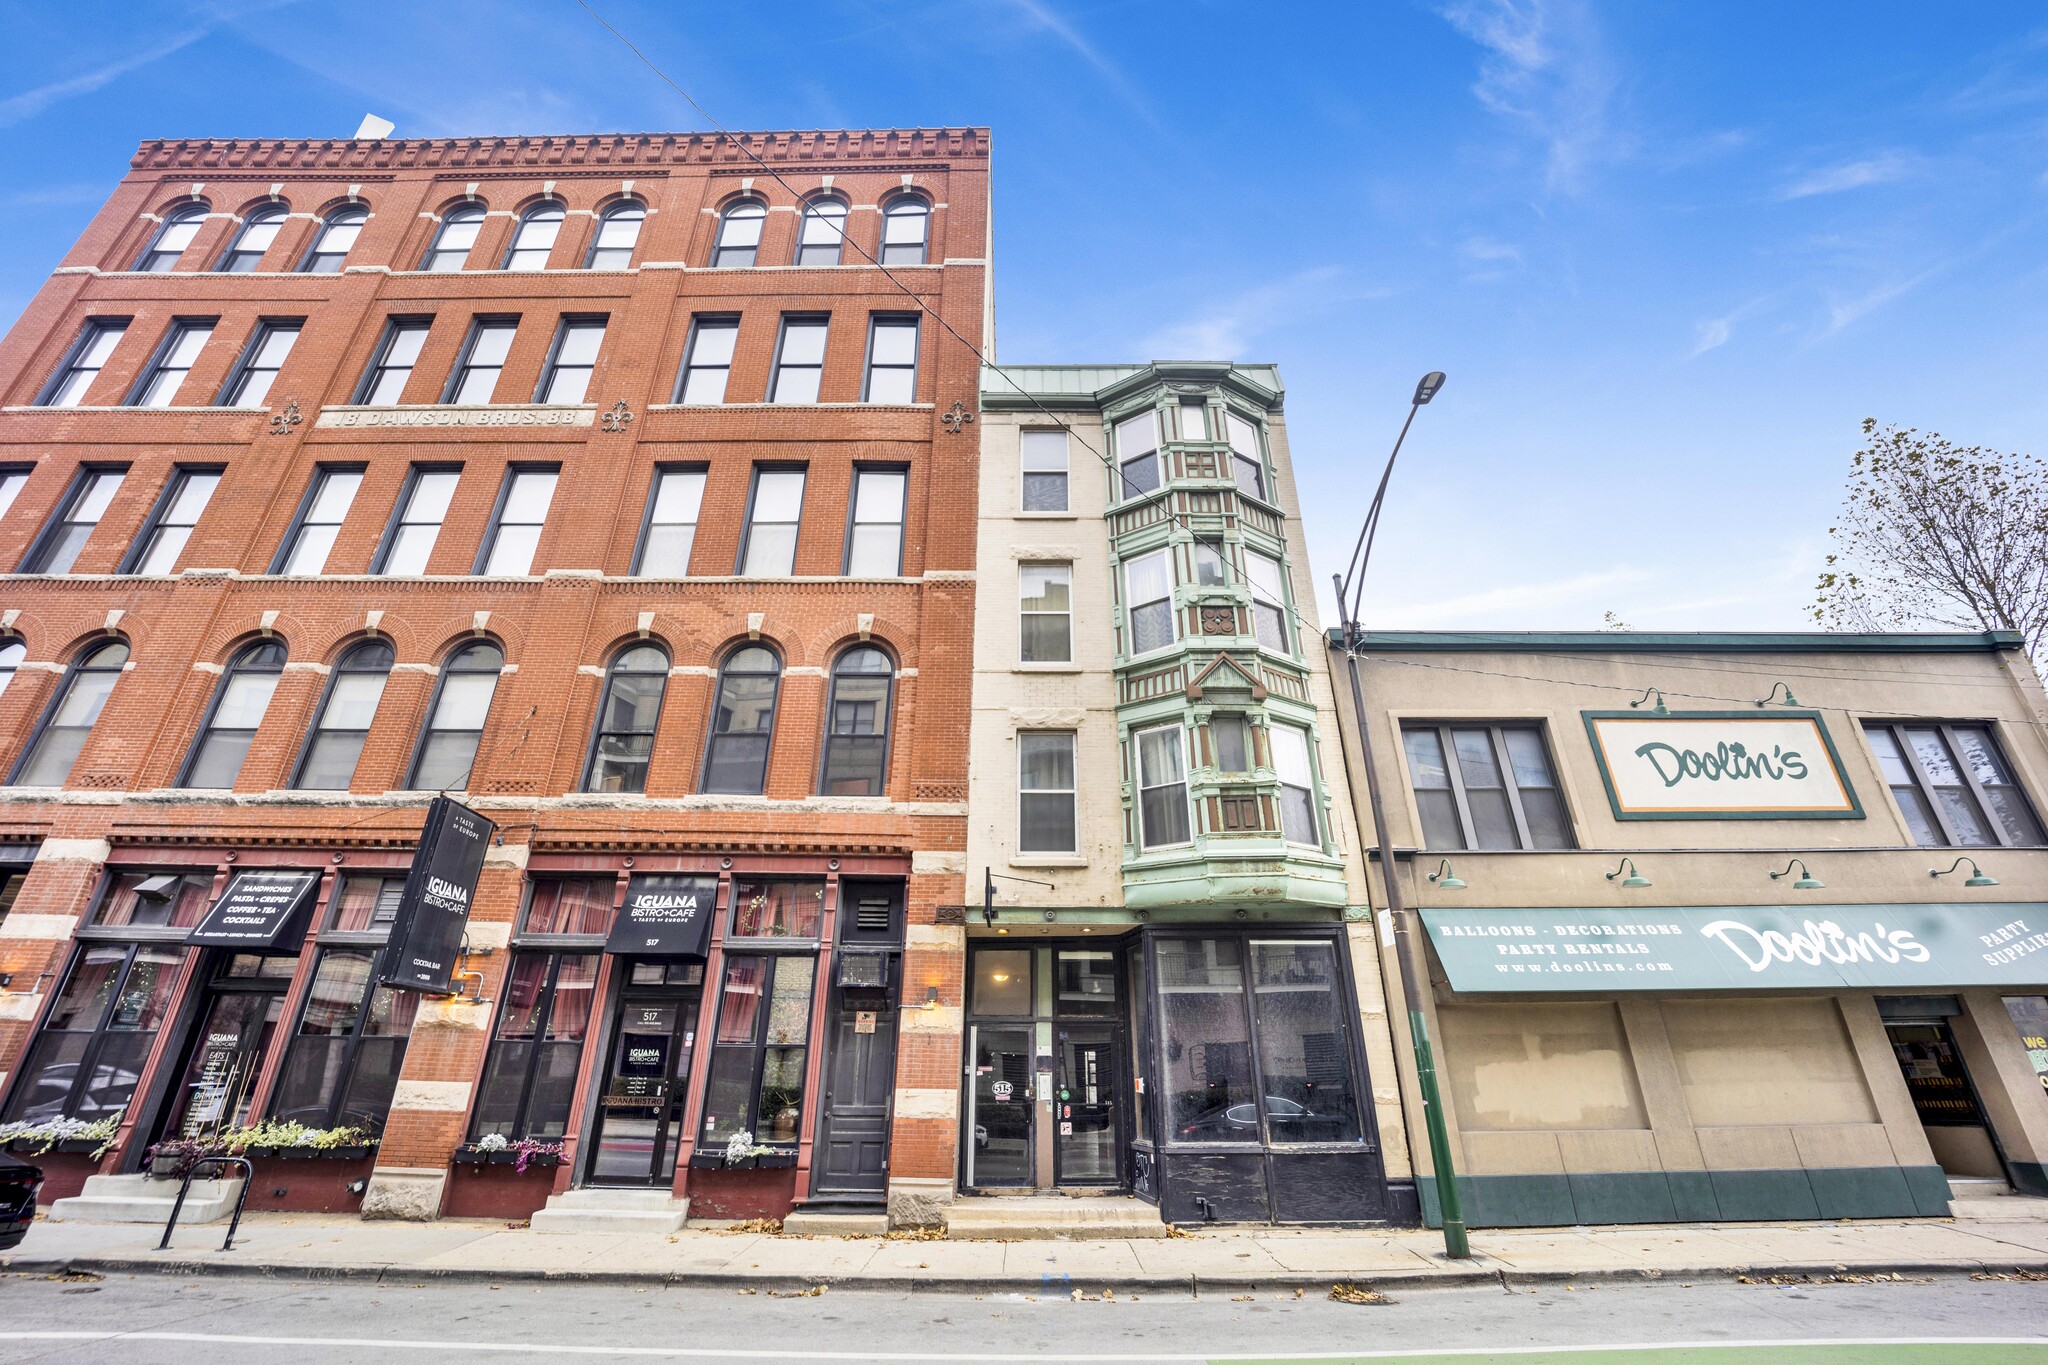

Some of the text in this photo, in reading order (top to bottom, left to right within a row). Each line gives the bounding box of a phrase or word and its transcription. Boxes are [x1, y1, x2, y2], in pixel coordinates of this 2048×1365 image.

[365, 410, 467, 426] DAWSON
[1634, 741, 1808, 787] Doolin's
[459, 817, 474, 829] TASTE
[459, 827, 480, 840] EUROPE
[242, 885, 293, 893] SANDWICHES
[427, 876, 467, 904] IGUANA
[633, 895, 697, 908] IGUANA
[1440, 925, 1536, 936] BALLOONS
[1554, 924, 1683, 936] DECORATIONS
[1979, 919, 2031, 948] PARTY
[1496, 943, 1651, 955] PARTY RENTALS
[1700, 920, 1931, 972] Doolin's
[413, 958, 441, 970] COCKTAIL BAR
[1494, 960, 1674, 973] www.doolins.com
[643, 1012, 658, 1021] 517
[209, 1033, 238, 1041] IGUANA
[209, 1051, 226, 1060] EATS
[629, 1048, 660, 1057] IGUANA
[993, 1083, 1012, 1093] 515
[634, 1097, 663, 1105] BISTRO
